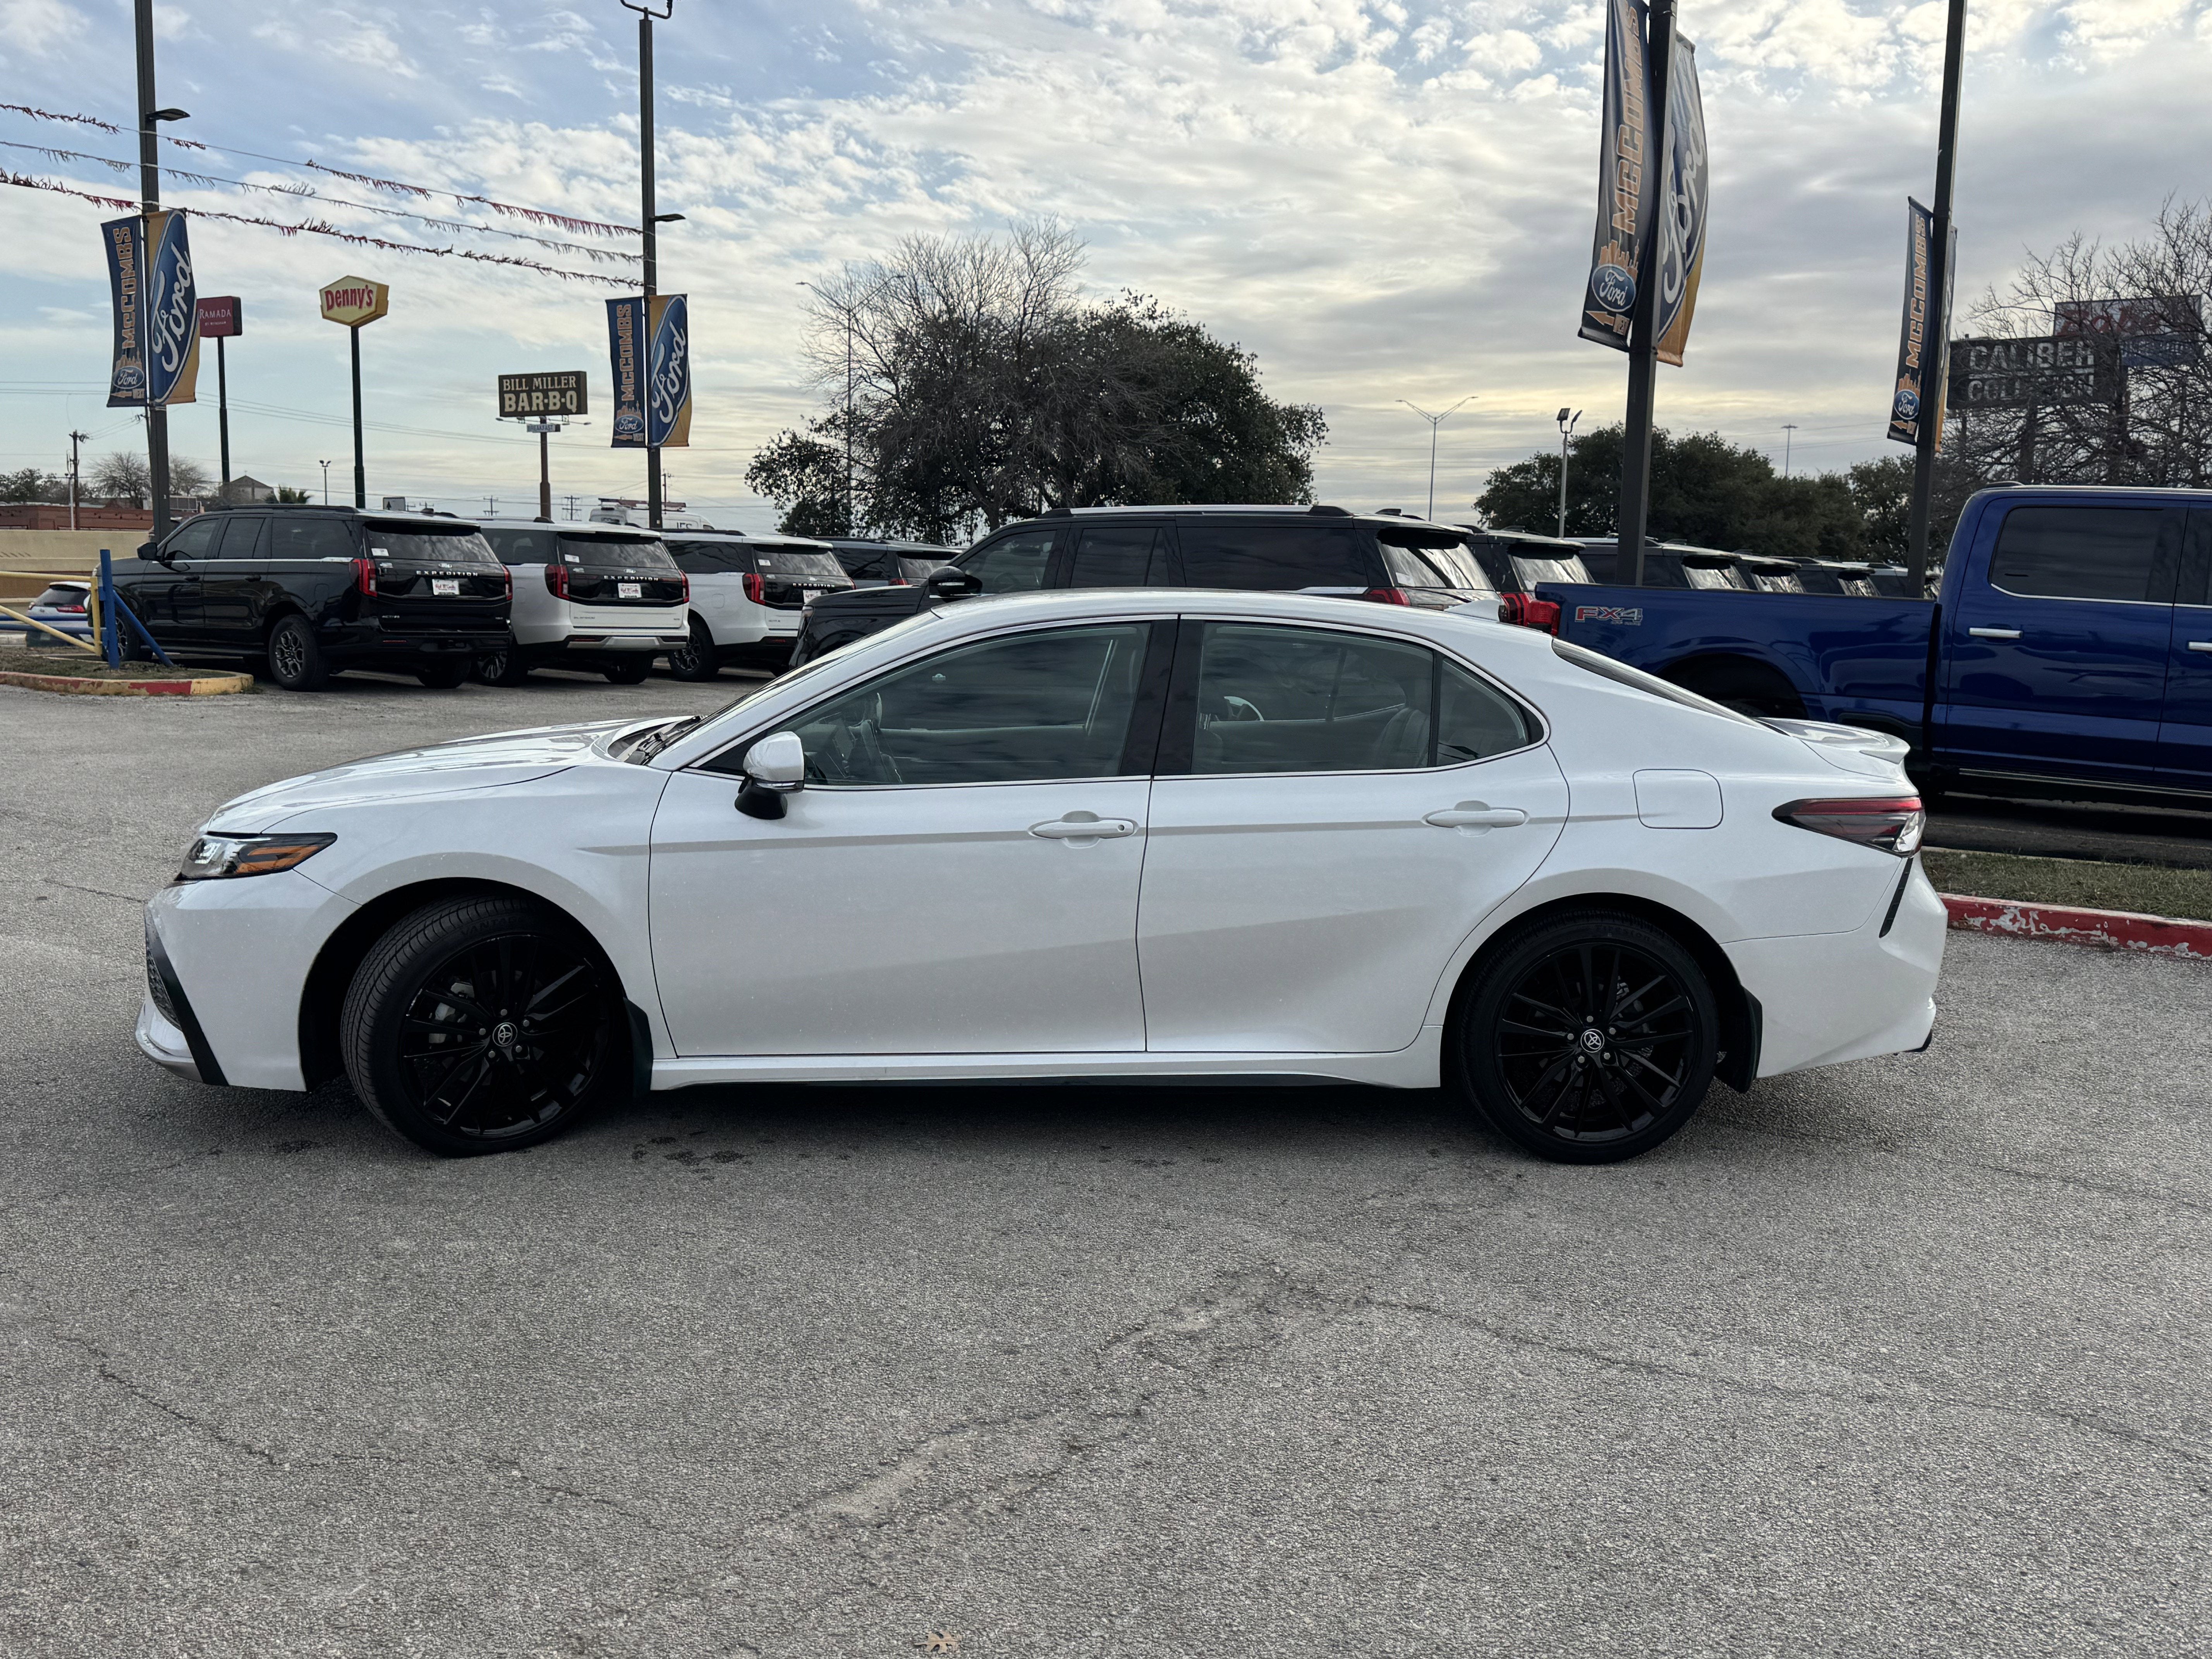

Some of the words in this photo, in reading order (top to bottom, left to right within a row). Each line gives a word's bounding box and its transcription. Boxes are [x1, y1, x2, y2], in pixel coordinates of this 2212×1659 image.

[325, 285, 373, 311] Denny's
[1599, 270, 1628, 306] Ford
[151, 242, 192, 372] Ford
[199, 309, 232, 319] RAMADA
[117, 369, 137, 385] Ford
[652, 320, 686, 423] Ford
[503, 378, 529, 391] BILL
[532, 376, 576, 390] MILLER
[504, 390, 577, 413] BAR-B-Q
[619, 418, 638, 430] Ford
[1575, 605, 1643, 622] FX4
